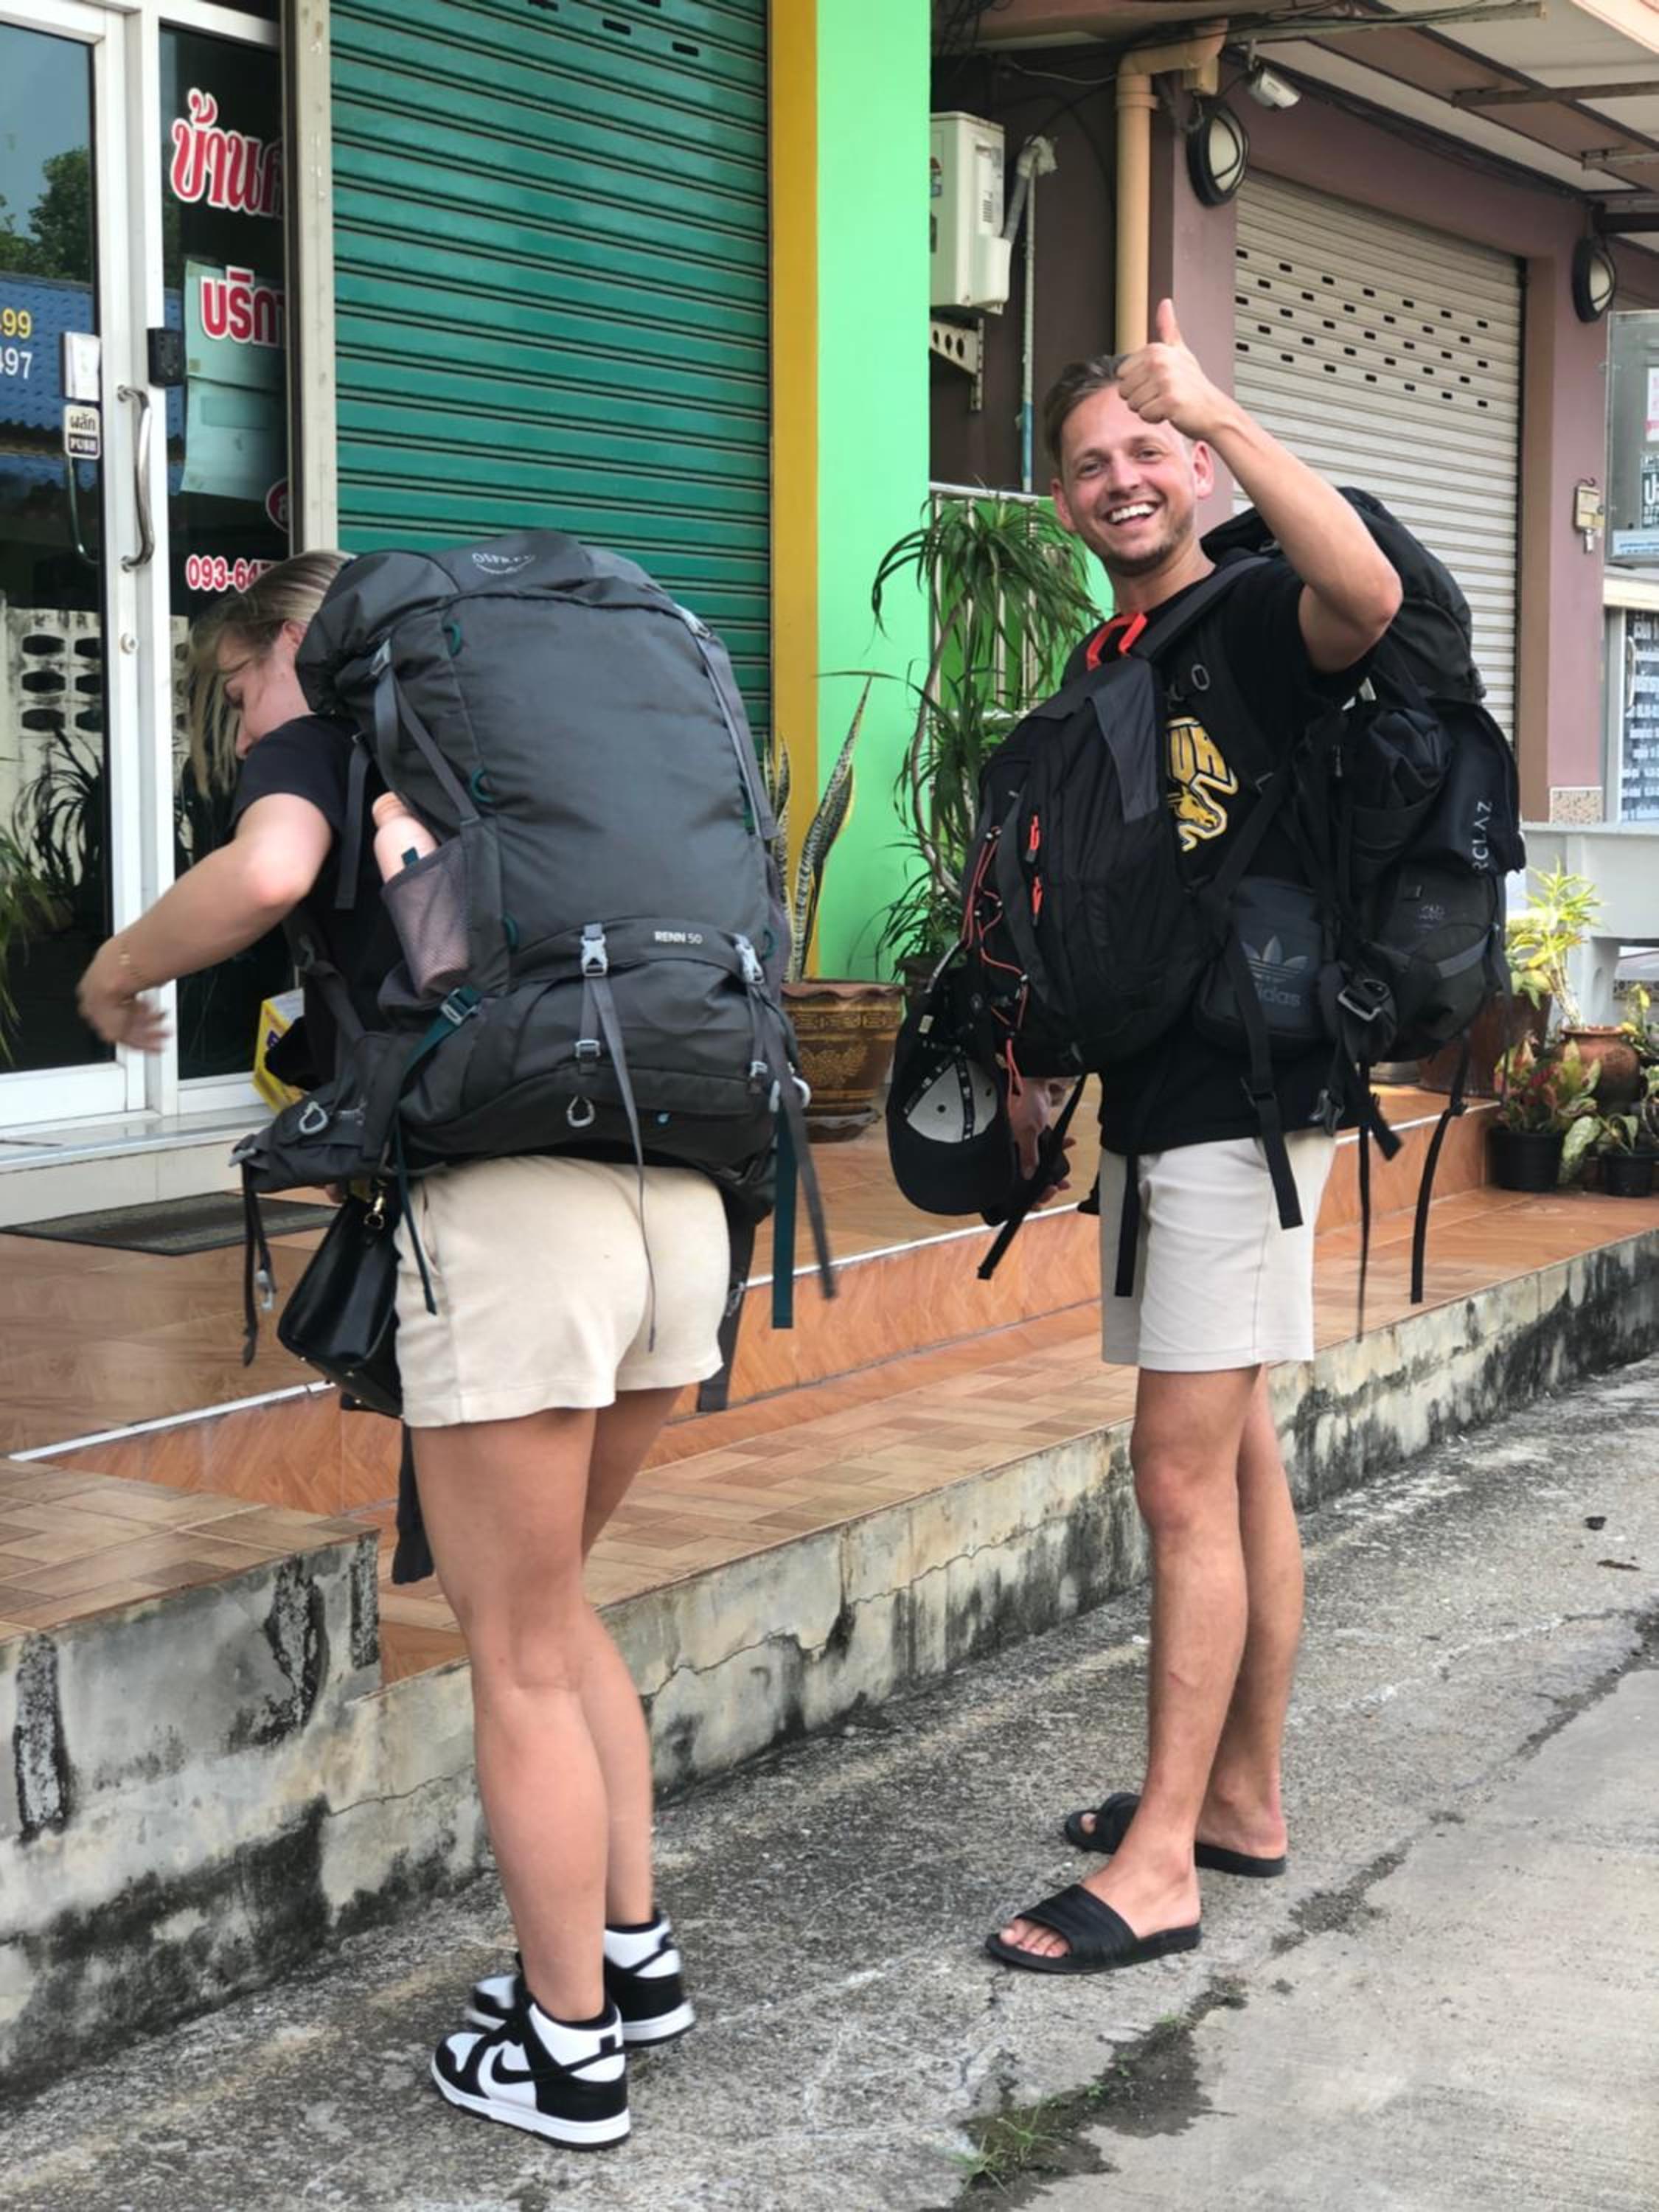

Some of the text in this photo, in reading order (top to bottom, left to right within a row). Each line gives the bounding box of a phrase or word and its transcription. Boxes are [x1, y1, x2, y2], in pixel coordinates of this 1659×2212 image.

[0, 307, 32, 339] 99
[0, 346, 32, 380] 97
[687, 933, 703, 945] 50
